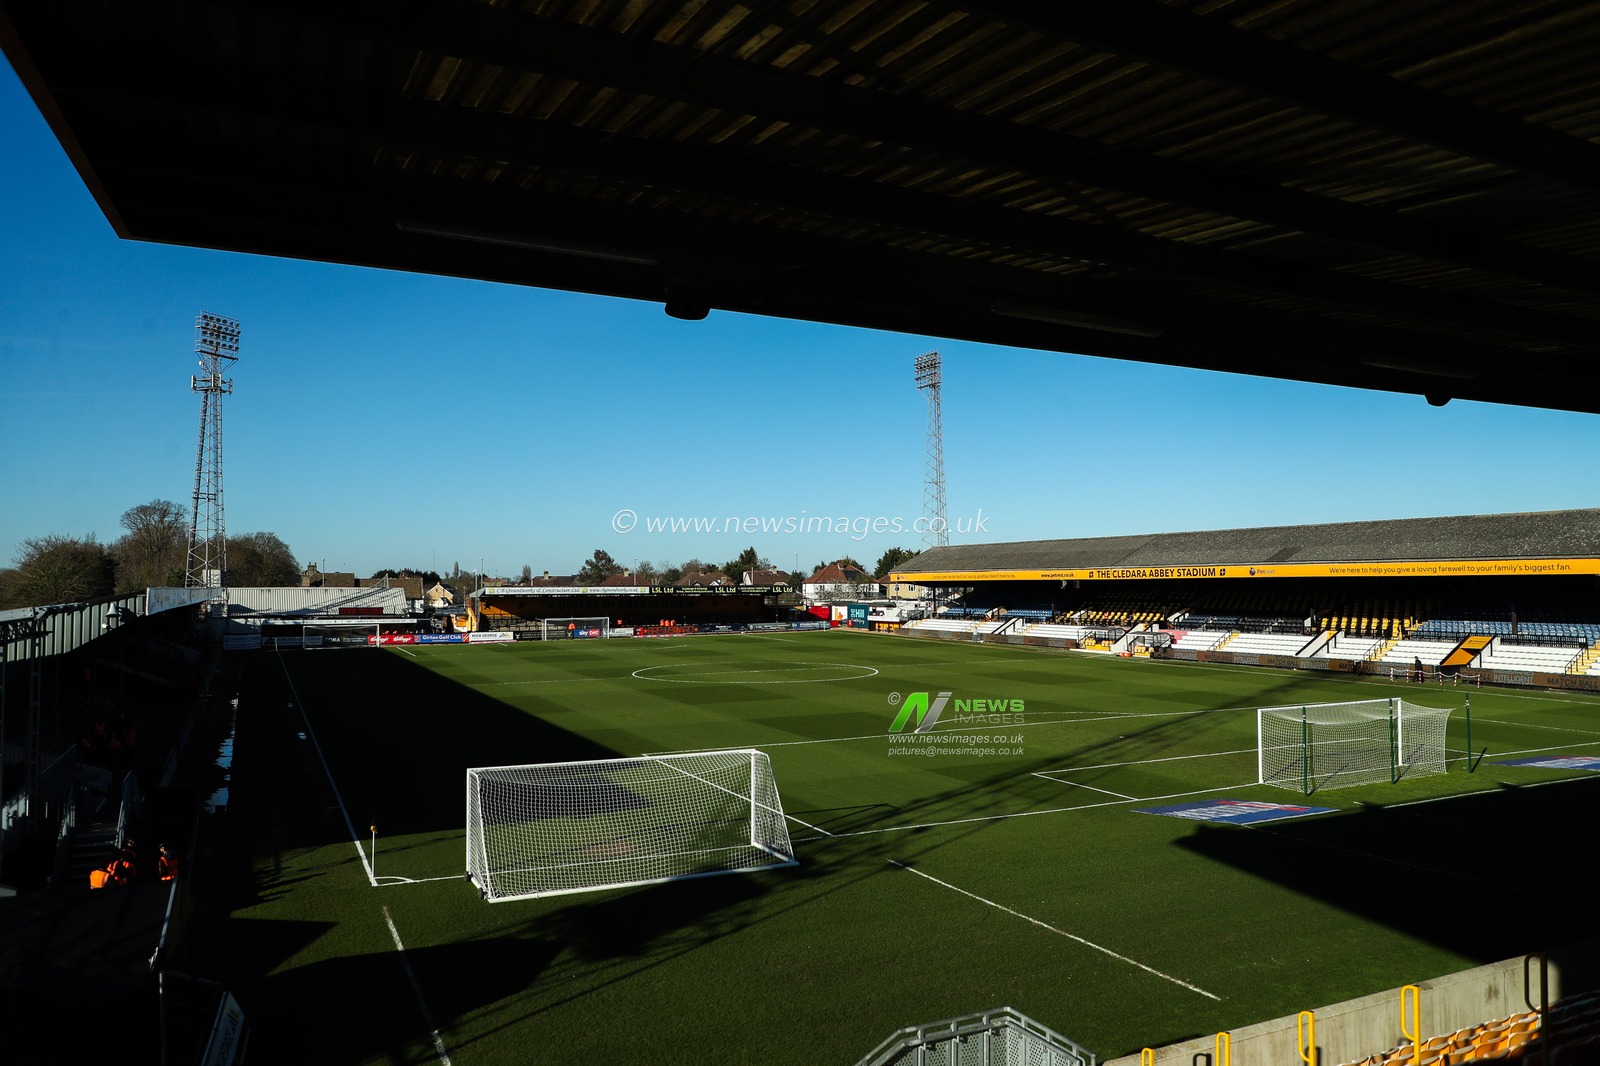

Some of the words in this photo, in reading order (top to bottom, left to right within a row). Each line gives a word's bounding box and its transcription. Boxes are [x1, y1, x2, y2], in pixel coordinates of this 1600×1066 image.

[1097, 570, 1111, 578] THE
[1112, 569, 1147, 578] CLEDARA
[1148, 568, 1175, 577] ABBEY
[1176, 568, 1216, 577] STADIUM
[1369, 566, 1383, 575] help
[1396, 566, 1410, 575] give
[1417, 566, 1437, 574] loving
[1494, 564, 1523, 573] family's
[1525, 564, 1554, 573] biggest
[1556, 563, 1572, 571] fan.
[651, 586, 662, 594] LSL
[664, 586, 674, 594] Ltd
[1493, 674, 1534, 683] INTELLIGENT
